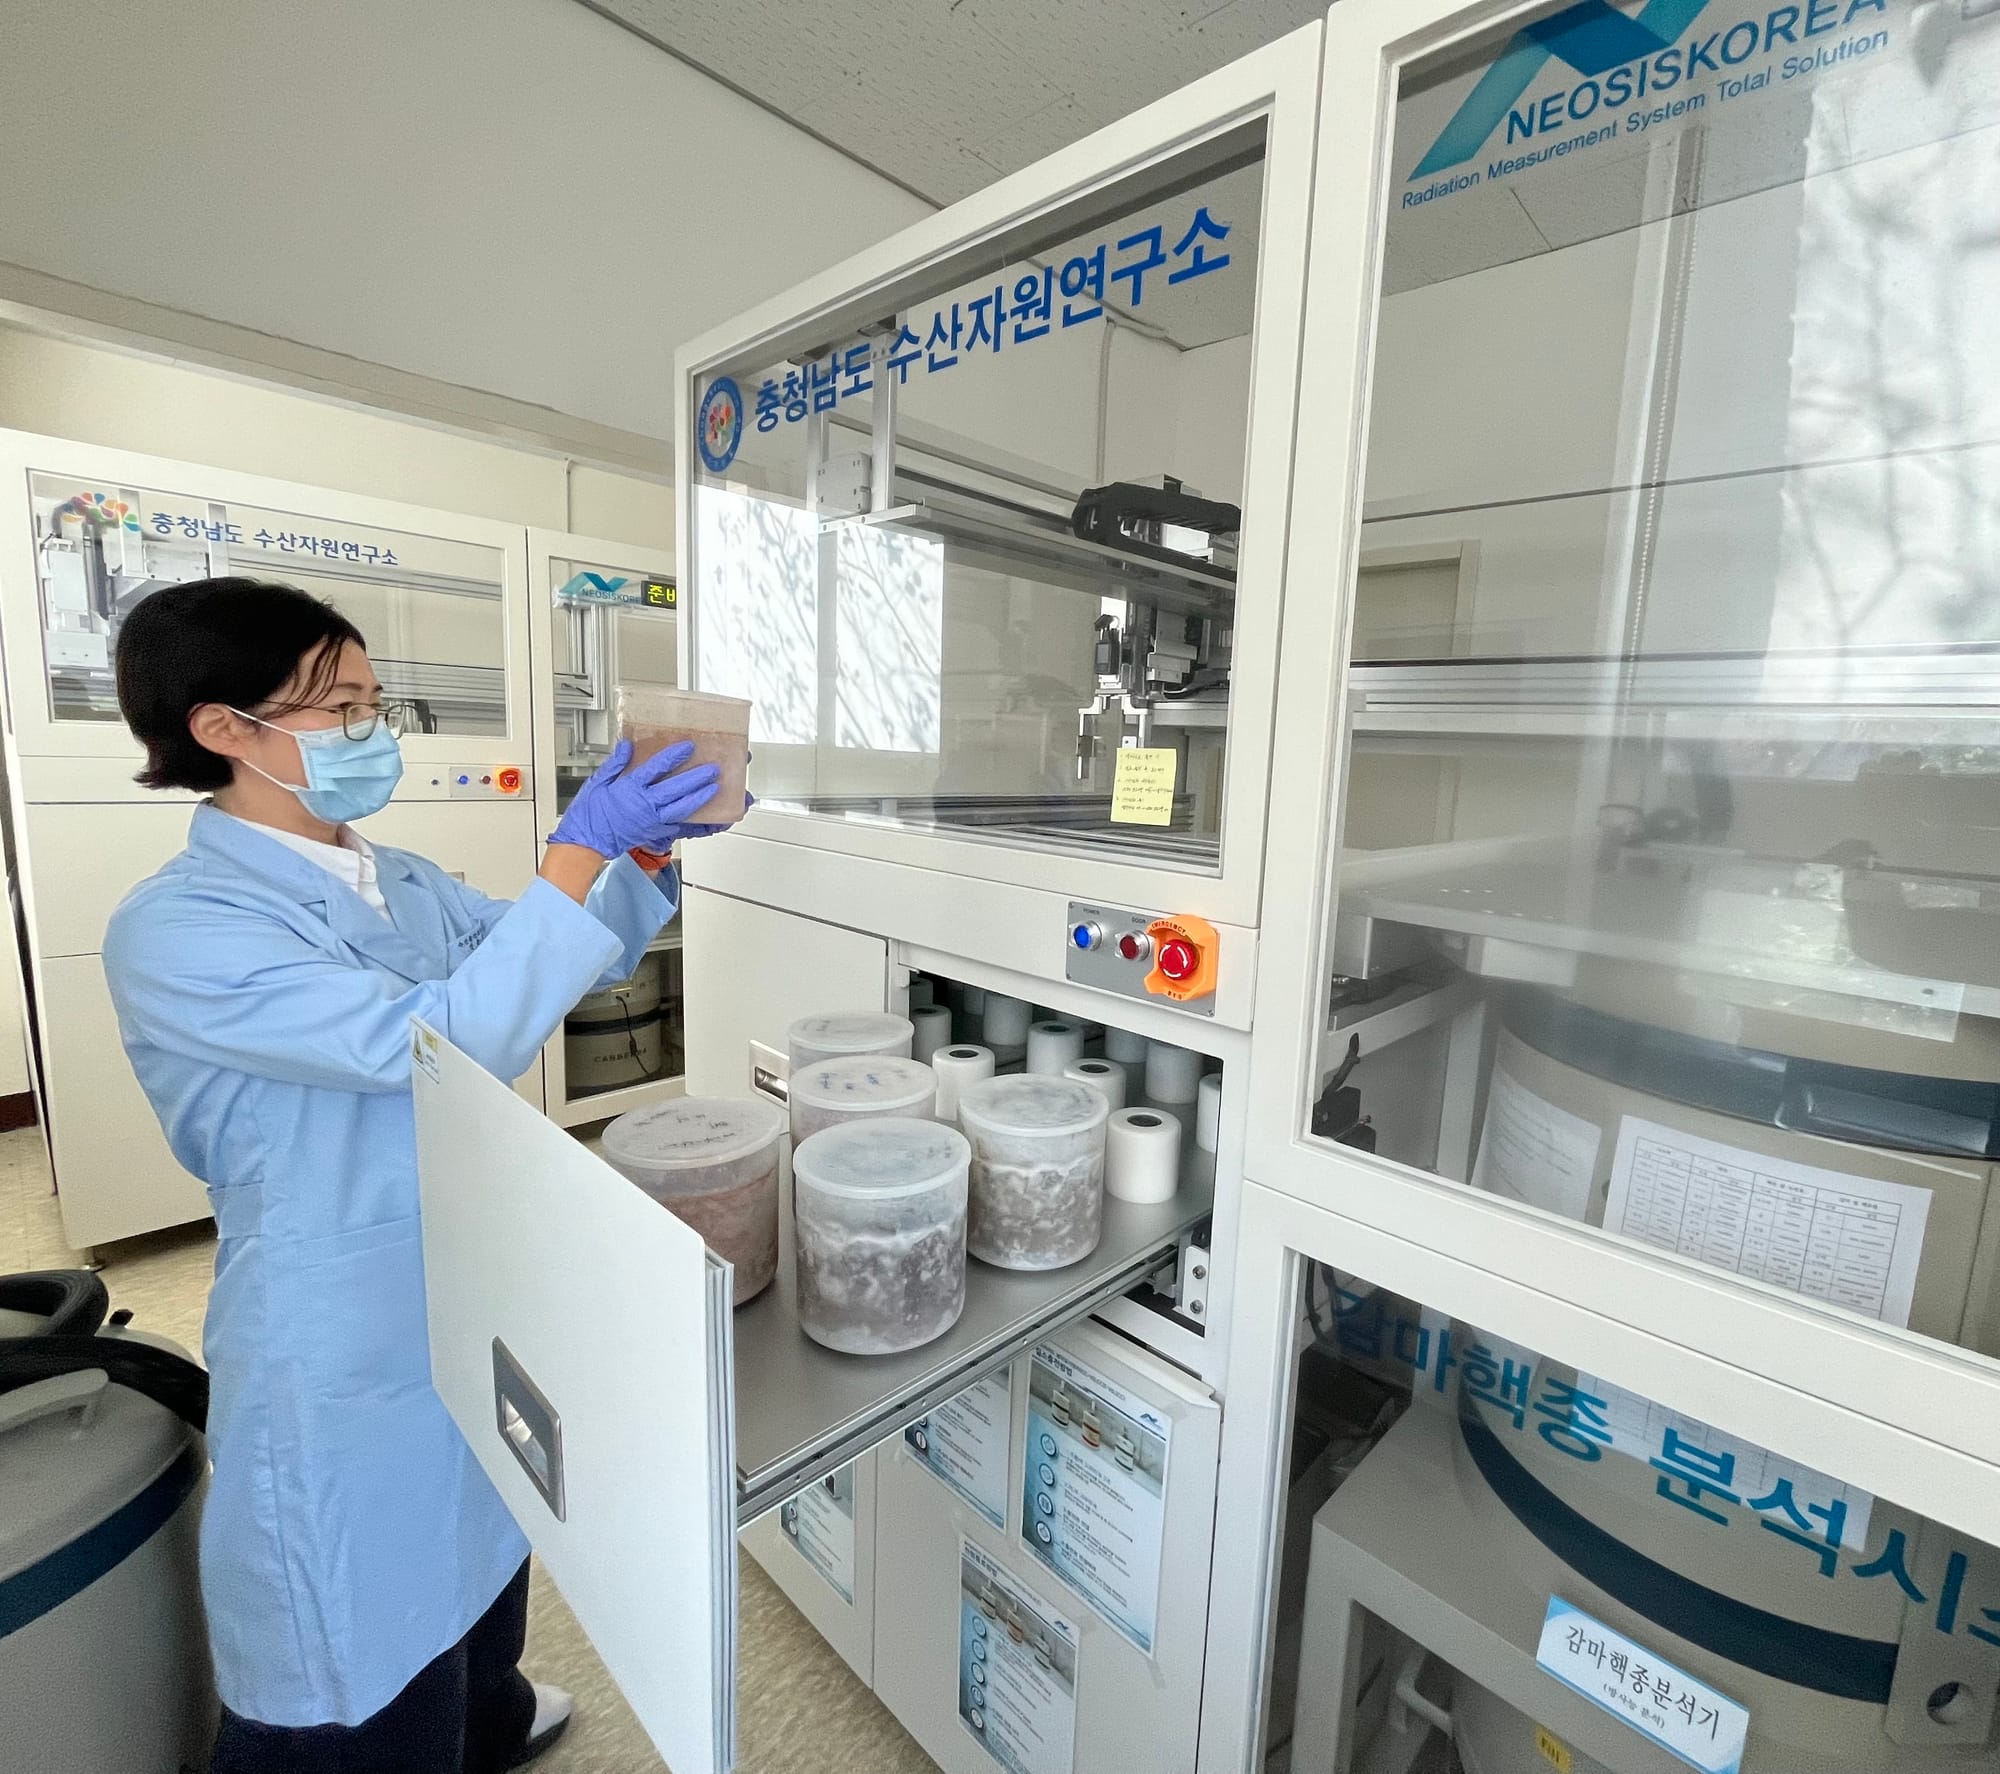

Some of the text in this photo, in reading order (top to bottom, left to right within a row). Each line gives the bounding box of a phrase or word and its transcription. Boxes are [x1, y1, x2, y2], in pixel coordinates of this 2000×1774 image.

[1401, 27, 1889, 210] Radiation Measurement System Total Solution
[1505, 0, 1888, 145] NEOSISKOREA
[755, 343, 873, 433] 충청남도
[886, 206, 1231, 386] 수산자원연구소
[150, 511, 399, 566] 충청남도 수산자원연구소
[1565, 1625, 1720, 1741] 감마핵종분석기
[1639, 1706, 1665, 1730] 분석)
